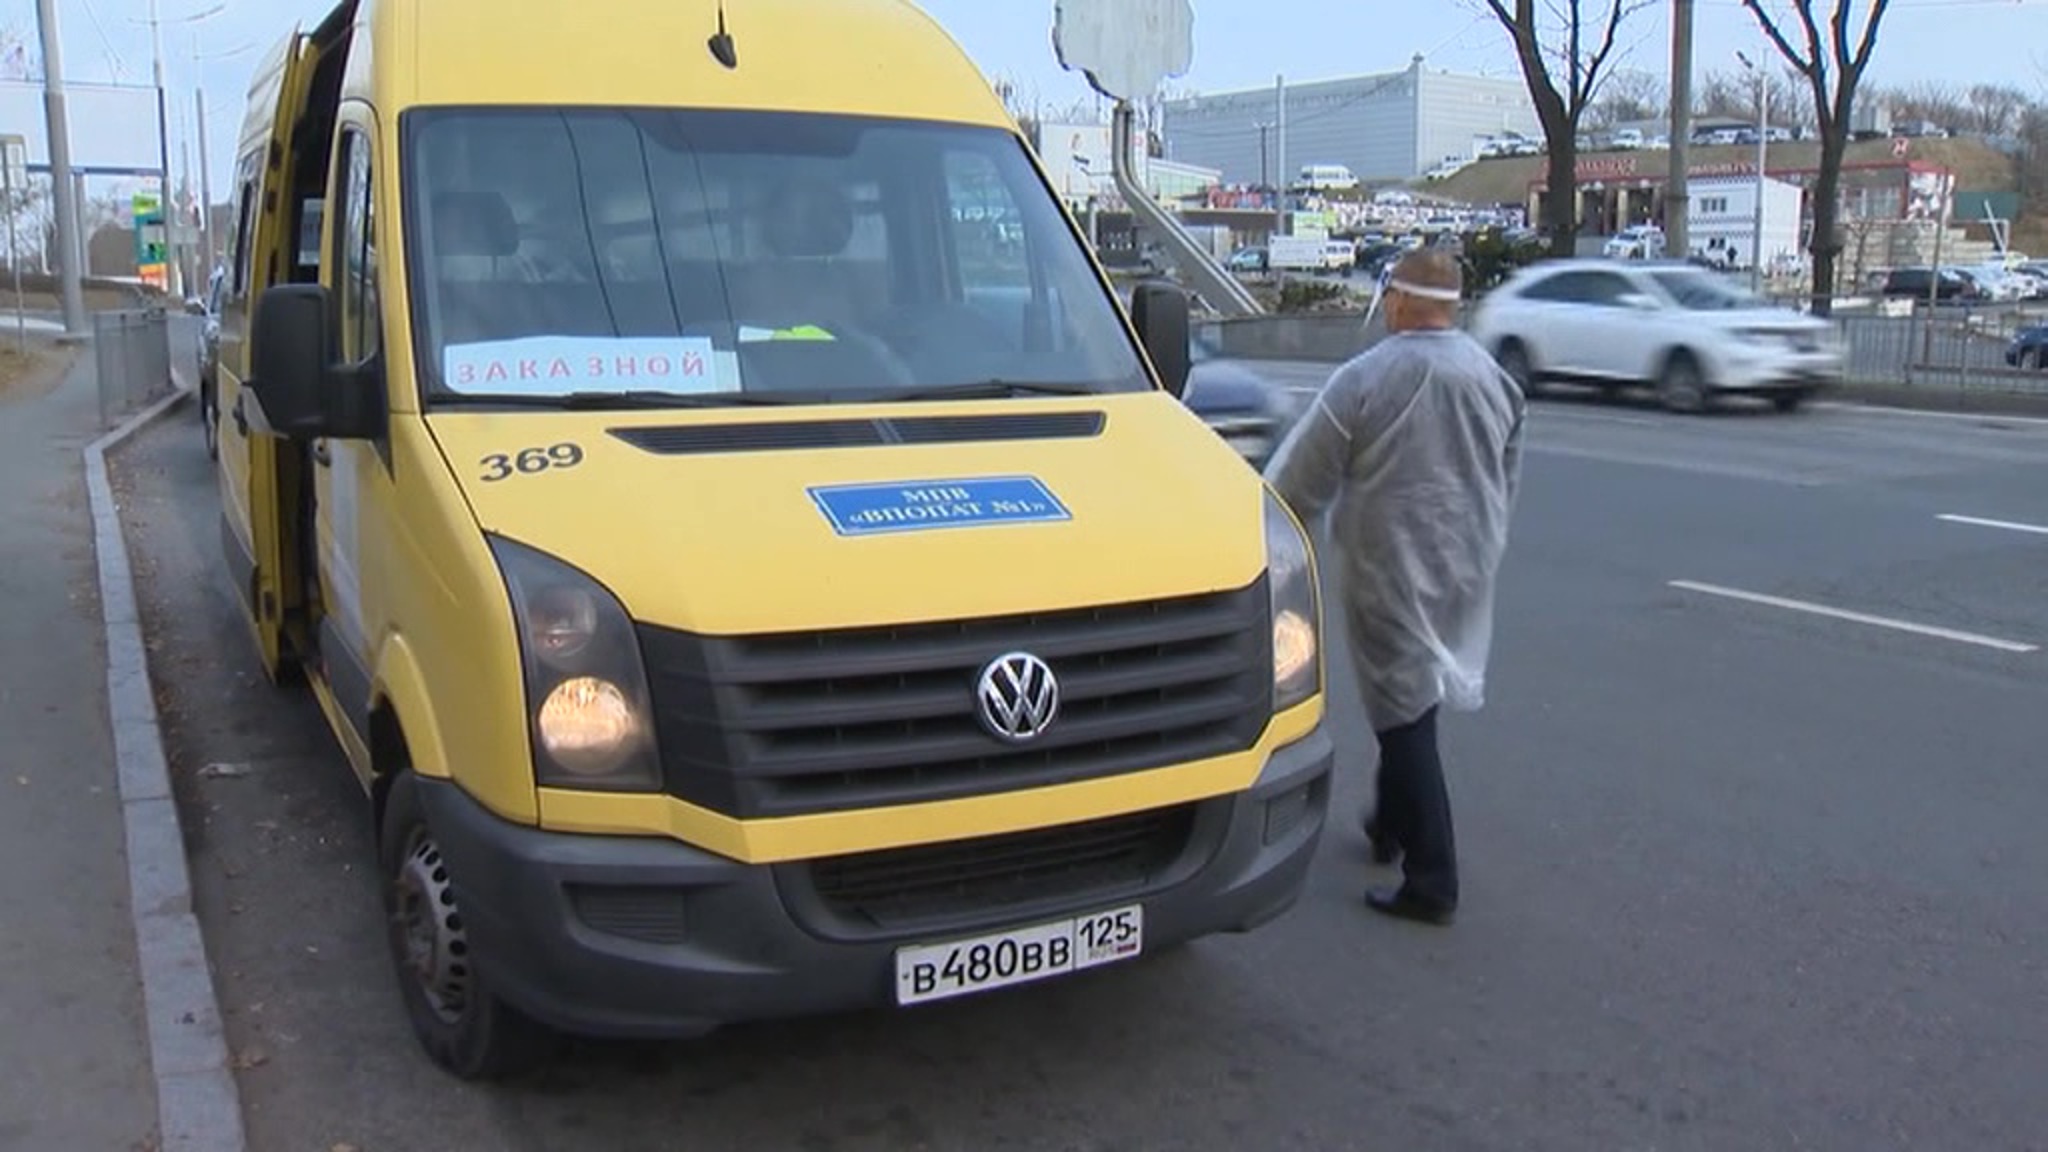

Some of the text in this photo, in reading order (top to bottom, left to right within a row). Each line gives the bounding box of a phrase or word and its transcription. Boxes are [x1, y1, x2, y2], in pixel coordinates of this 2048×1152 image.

[456, 351, 705, 385] ЗАКАЗНОЙ
[480, 442, 583, 482] 369
[901, 486, 970, 503] МПВ
[850, 501, 983, 523] «ВПОПАТ
